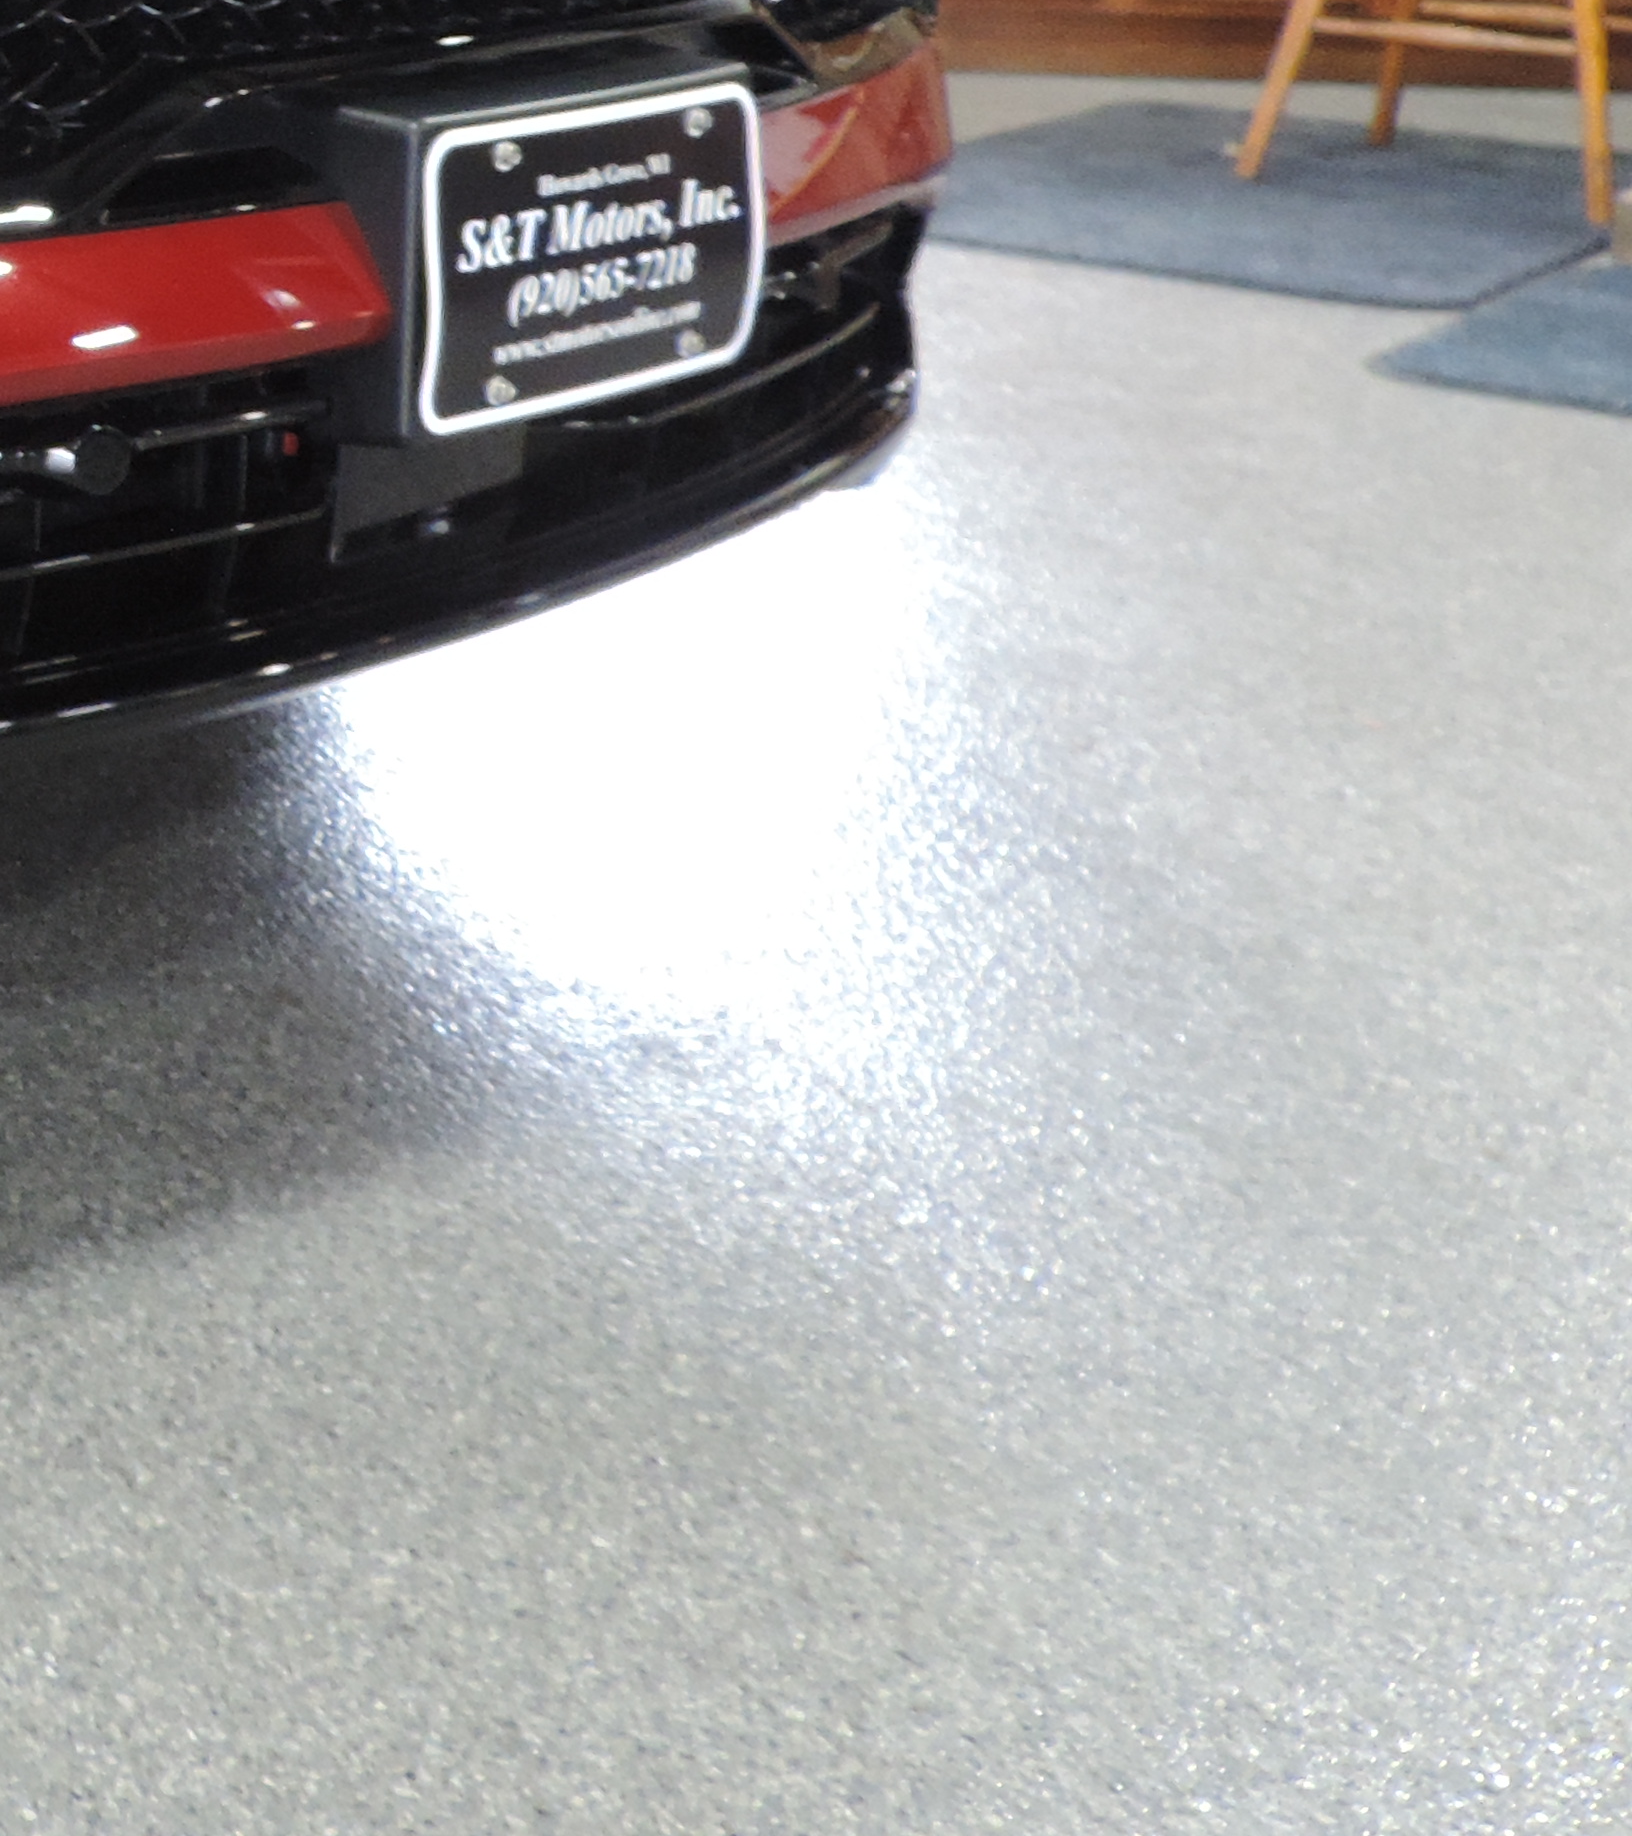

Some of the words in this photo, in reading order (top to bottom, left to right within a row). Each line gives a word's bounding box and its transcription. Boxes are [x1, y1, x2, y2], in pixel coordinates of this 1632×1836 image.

[455, 209, 548, 274] S&T
[546, 200, 674, 255] Motors,
[679, 178, 742, 228] Inc.
[507, 242, 698, 328] (920)565-7218
